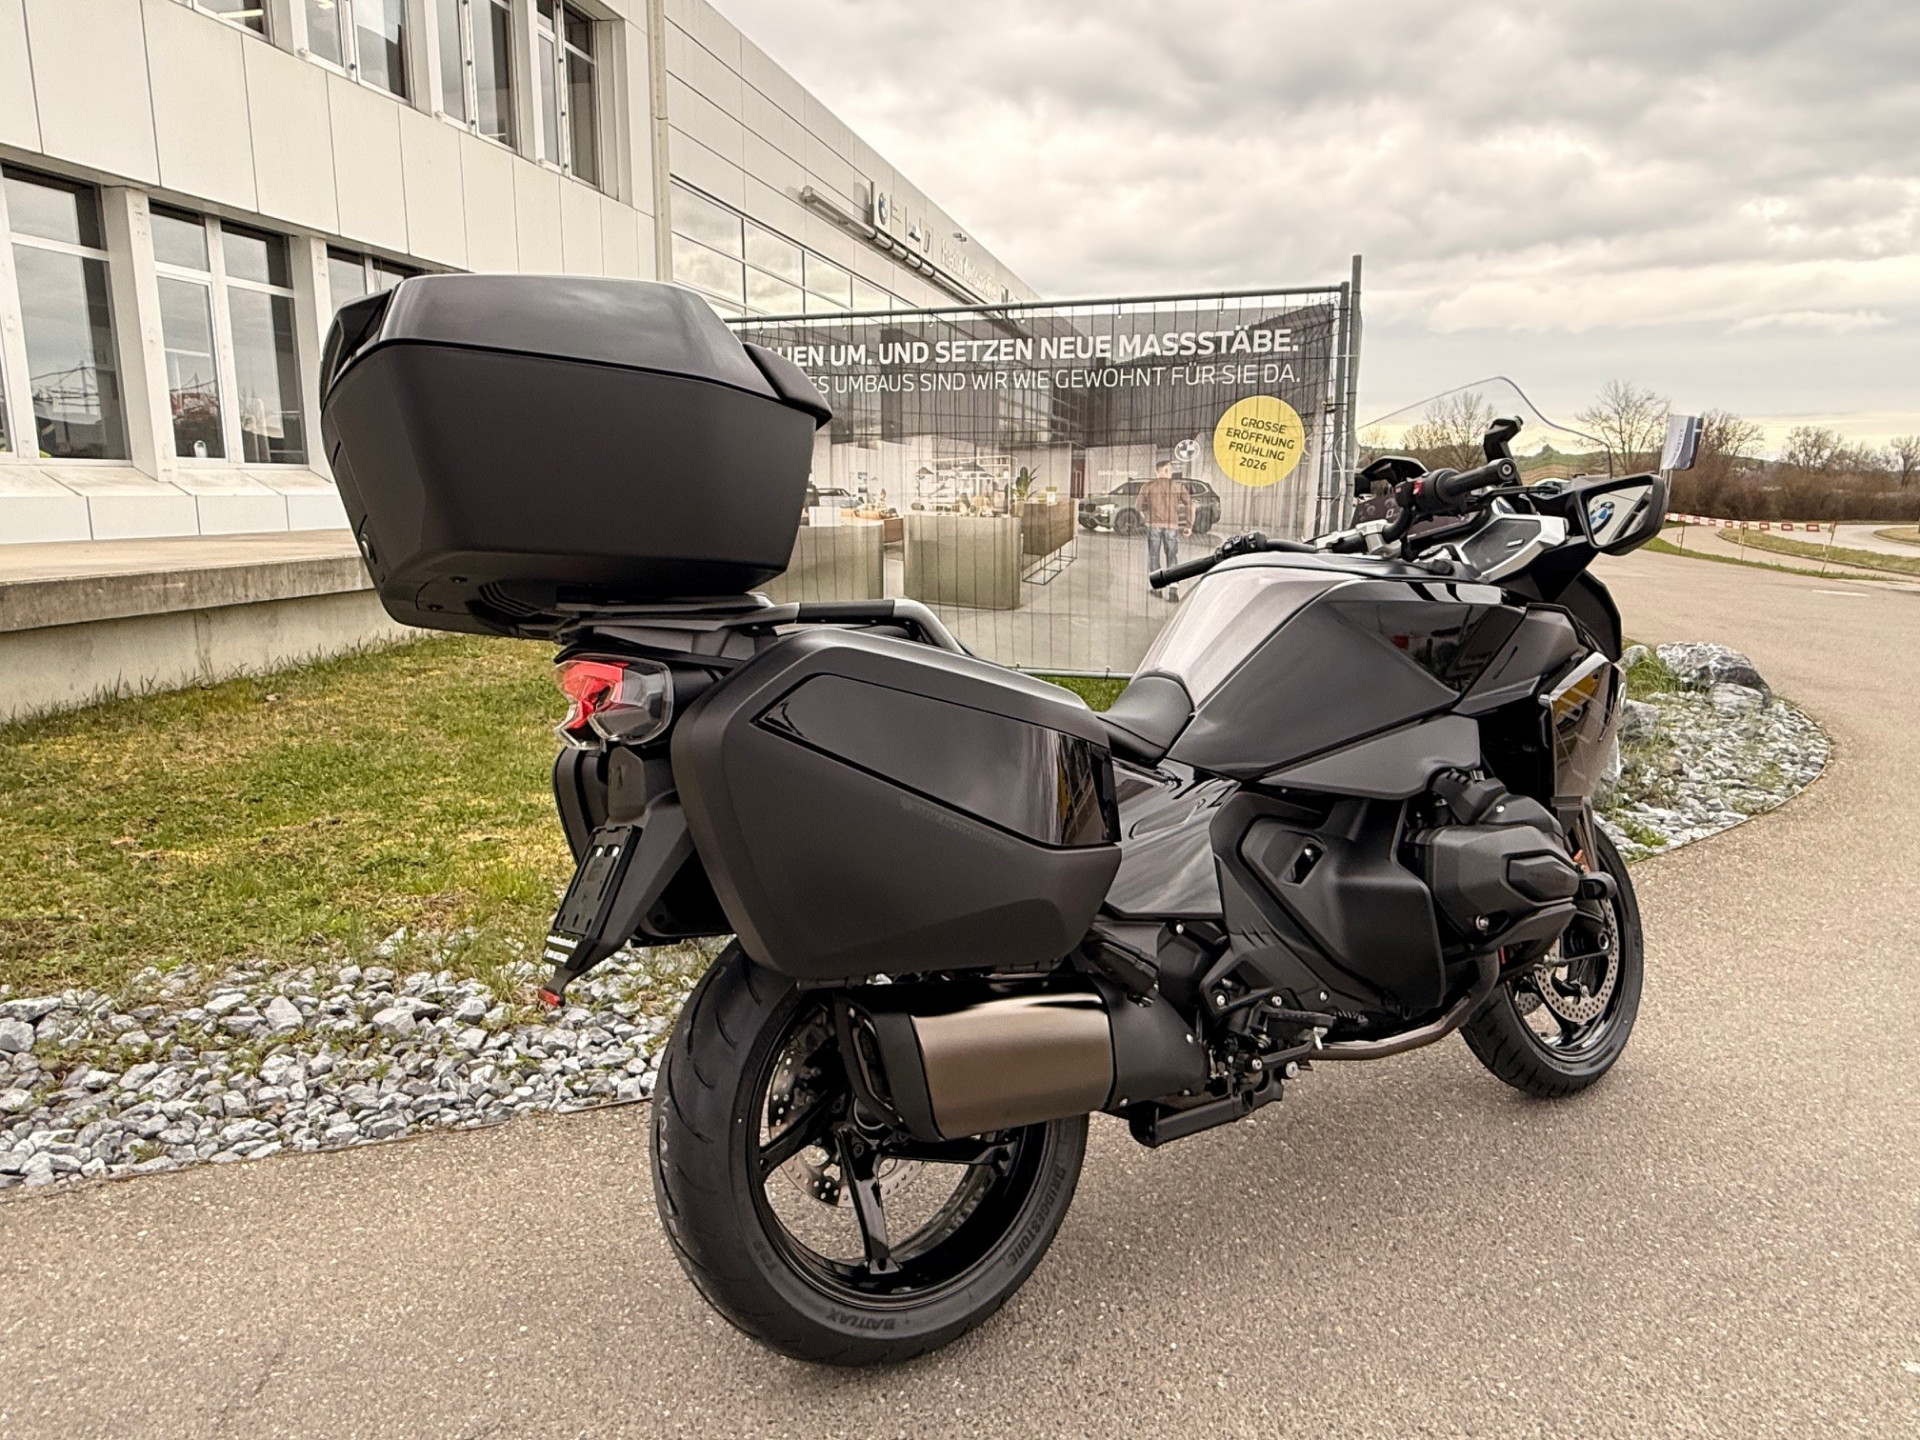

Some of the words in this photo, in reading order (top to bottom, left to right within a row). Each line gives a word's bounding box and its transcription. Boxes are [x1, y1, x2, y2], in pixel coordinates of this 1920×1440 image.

[766, 345, 824, 367] UEN
[830, 344, 873, 366] UM.
[878, 342, 929, 365] UND
[935, 338, 1033, 363] SETZEN
[1040, 335, 1112, 360] NEUE
[1118, 325, 1299, 357] MASSSTÄBE.
[835, 373, 915, 393] UMBAUS
[920, 372, 966, 392] SIND
[971, 371, 1008, 390] WIR
[1013, 370, 1050, 389] WIE
[1055, 366, 1167, 389] GEWOHNT
[1171, 362, 1215, 386] FÜR
[1222, 364, 1257, 385] SIE
[1263, 363, 1301, 384] DA.
[1240, 417, 1287, 434] GROSSE
[1226, 427, 1295, 449] ERÖFFNUNG
[1228, 441, 1286, 461] FRÜHLING
[1239, 456, 1267, 471] 2026
[1006, 1164, 1067, 1265] BRIDGESTONE
[826, 1308, 897, 1330] BATTLAX
